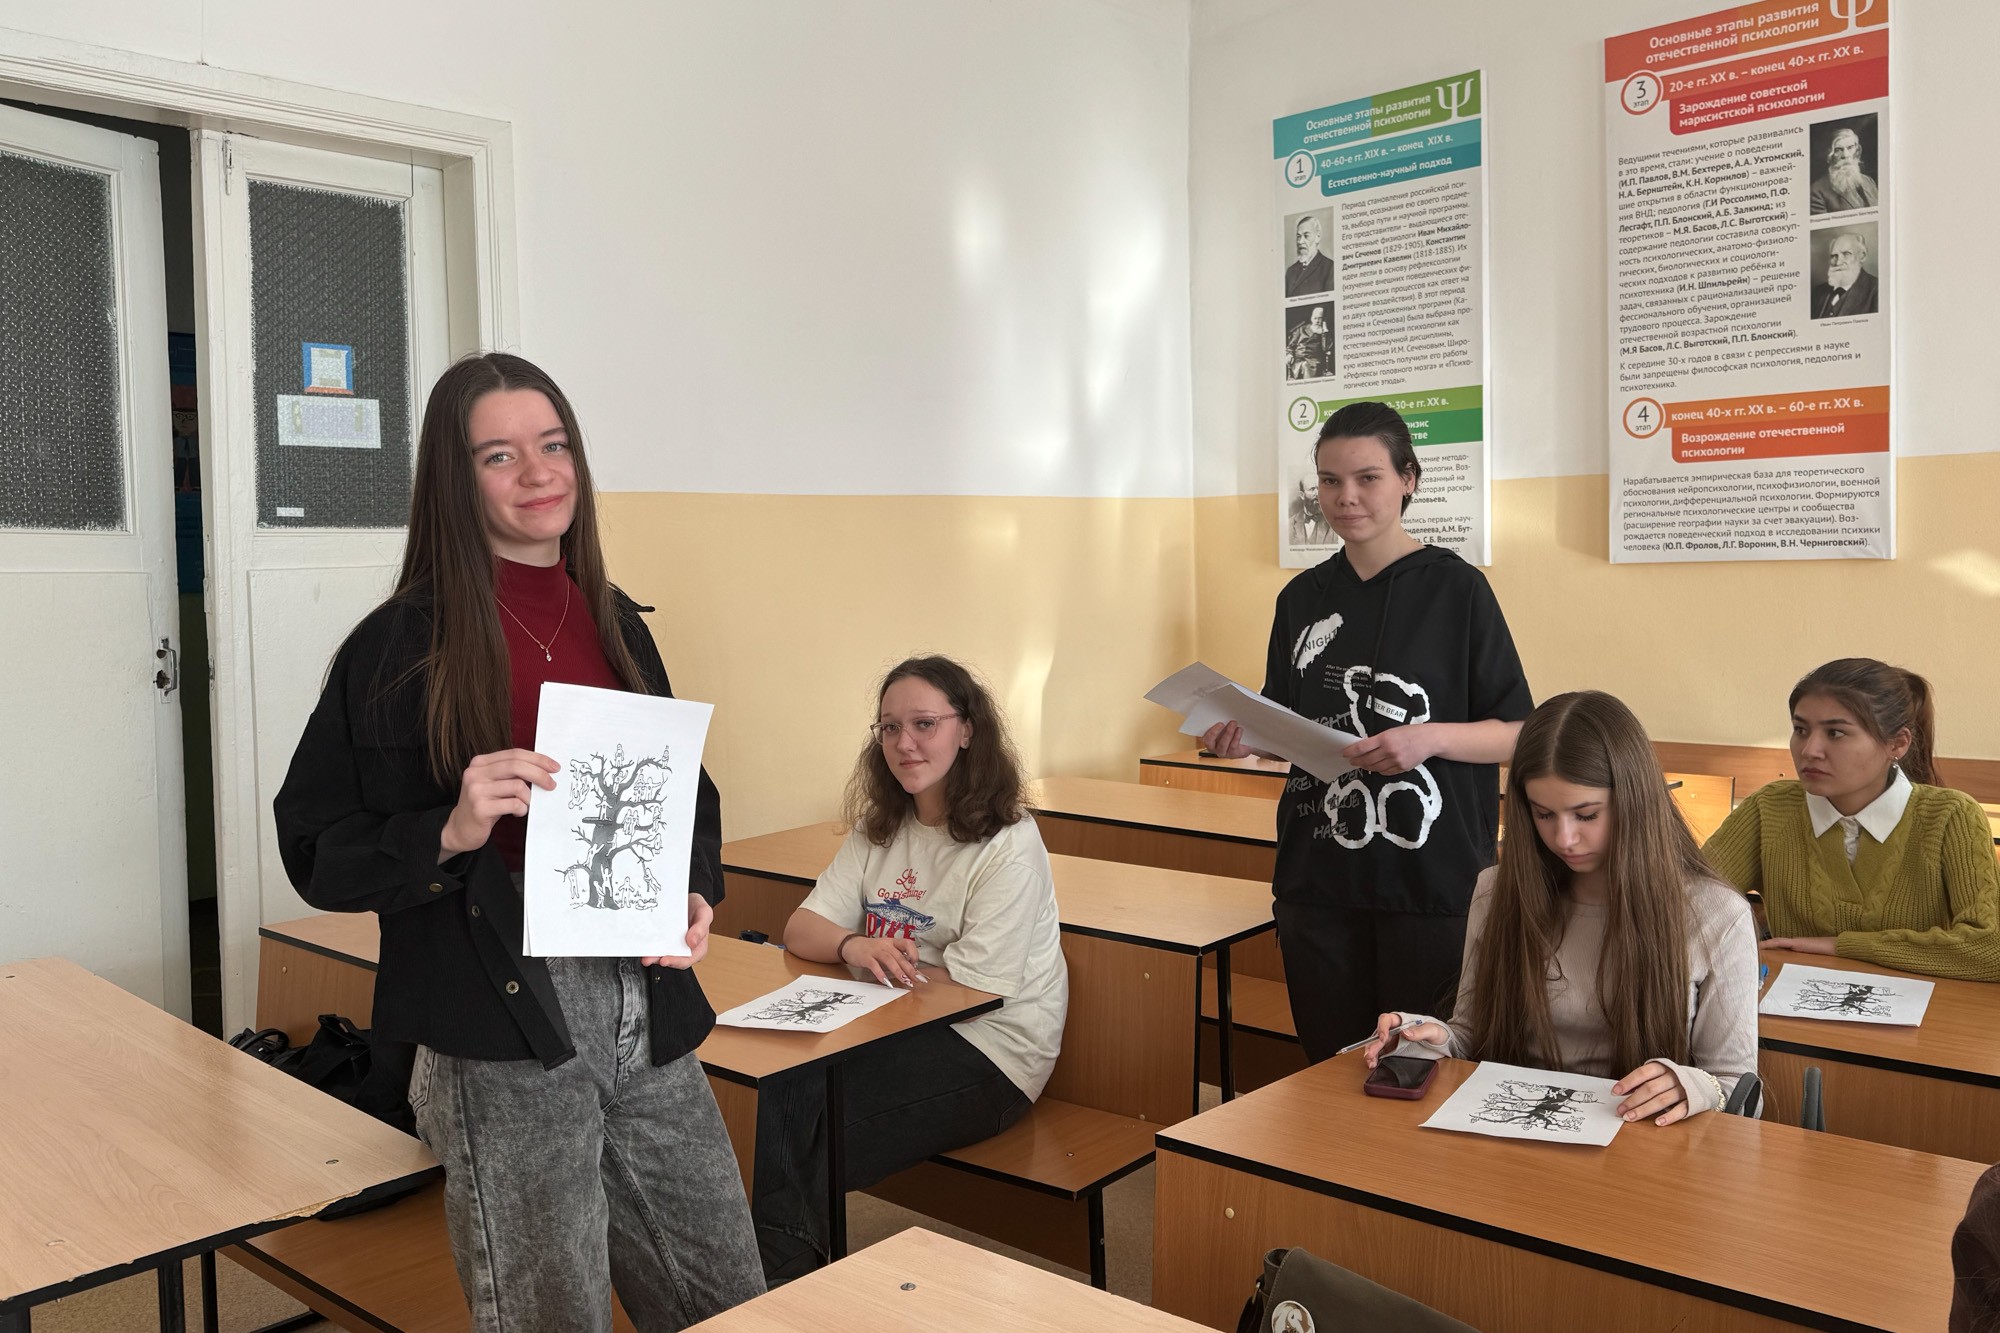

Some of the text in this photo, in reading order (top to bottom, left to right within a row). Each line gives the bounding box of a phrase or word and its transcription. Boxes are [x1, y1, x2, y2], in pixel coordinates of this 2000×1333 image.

[1649, 2, 1819, 49] Основные этапы развития
[1645, 17, 1819, 63] отечественной психологии
[1669, 80, 1694, 92] 20-е
[1696, 77, 1708, 87] гг.
[1709, 70, 1726, 84] XX
[1728, 71, 1739, 80] в.
[1750, 61, 1786, 76] конец
[1787, 55, 1815, 67] 40-х
[1817, 52, 1831, 62] гг.
[1832, 45, 1850, 59] XX
[1853, 45, 1864, 55] в.
[1636, 80, 1647, 99] 3
[1678, 79, 1808, 114] Зарождение советской
[1305, 94, 1431, 131] Основные этапы развития
[1633, 99, 1649, 108] этап
[1679, 92, 1825, 127] марксистской психологии
[1303, 107, 1431, 144] отечественной психологии
[1320, 155, 1353, 169] 40-60-е
[1354, 153, 1364, 162] гг.
[1363, 147, 1379, 160] XIX
[1380, 148, 1389, 156] в.
[1397, 140, 1424, 152] конец
[1427, 133, 1444, 146] XIX
[1444, 134, 1453, 142] в.
[1296, 158, 1304, 175] 1
[1327, 156, 1453, 189] Естественно-научный подход
[1618, 148, 1804, 190] (И.П. Павлов, В.М. Бехтерев, А.А. Ухтомский,
[1293, 174, 1306, 182] этап
[1618, 189, 1635, 199] Н.А.
[1636, 181, 1685, 196] Бернштейн,
[1685, 177, 1703, 188] К.Н.
[1704, 169, 1750, 185] Корнилов)
[1759, 162, 1796, 176] важней-
[1341, 181, 1467, 211] Период становления российской пси-
[1341, 222, 1471, 250] чественные физиологи Иван Михайло-
[1341, 234, 1466, 261] вич Сеченов (1829-1905), Константин
[1341, 243, 1467, 272] Дмитриевич Кавелин (1818-1885). Их
[1619, 329, 1798, 357] (М.Я Басов, Л.С. Выготский, П.П. Блонский).
[1343, 370, 1378, 380] «Рефлексы
[1379, 366, 1413, 376] головного
[1413, 363, 1437, 372] мозга»
[1444, 359, 1473, 368] «Психо-
[1299, 403, 1308, 420] 2
[1415, 400, 1426, 408] гг.
[1426, 396, 1440, 407] XX
[1440, 398, 1449, 406] в.
[1671, 411, 1704, 421] конец
[1705, 407, 1732, 418] 40-х
[1734, 407, 1746, 416] гг.
[1747, 403, 1764, 415] XX
[1766, 405, 1777, 414] в.
[1788, 400, 1816, 412] 60-е
[1818, 401, 1832, 410] гг.
[1833, 397, 1851, 409] XX
[1853, 398, 1864, 408] в.
[1637, 405, 1650, 423] 4
[1681, 422, 1845, 444] Возрождение отечественной
[1441, 454, 1469, 462] методо-
[1681, 446, 1745, 458] психологии
[1622, 476, 1880, 496] обоснования нейропсихологии, психофизиологии, военной
[1623, 467, 1865, 487] Нарабатывается эмпирическая база для теоретического
[1446, 484, 1475, 493] раскры-
[1623, 490, 1880, 508] психологии, дифференциальной психологии. Формируются
[1427, 515, 1473, 525] первые науч-
[1440, 525, 1457, 533] А.М.
[1457, 524, 1472, 534] Бут-
[1422, 535, 1436, 543] С.Б.
[1436, 535, 1468, 543] Веселов-
[1623, 532, 1666, 542] рождается
[1667, 529, 1732, 539] поведенческий
[1733, 530, 1766, 538] подход
[1775, 528, 1839, 536] исследовании
[1623, 537, 1870, 552] человека (Ю.П. Фролов, Л.Г. Воронин, В.Н. Черниговский).
[1386, 706, 1405, 719] BEAR
[1297, 799, 1315, 817] IN
[1327, 793, 1360, 811] BLUE
[877, 888, 927, 901] Go Fishing!
